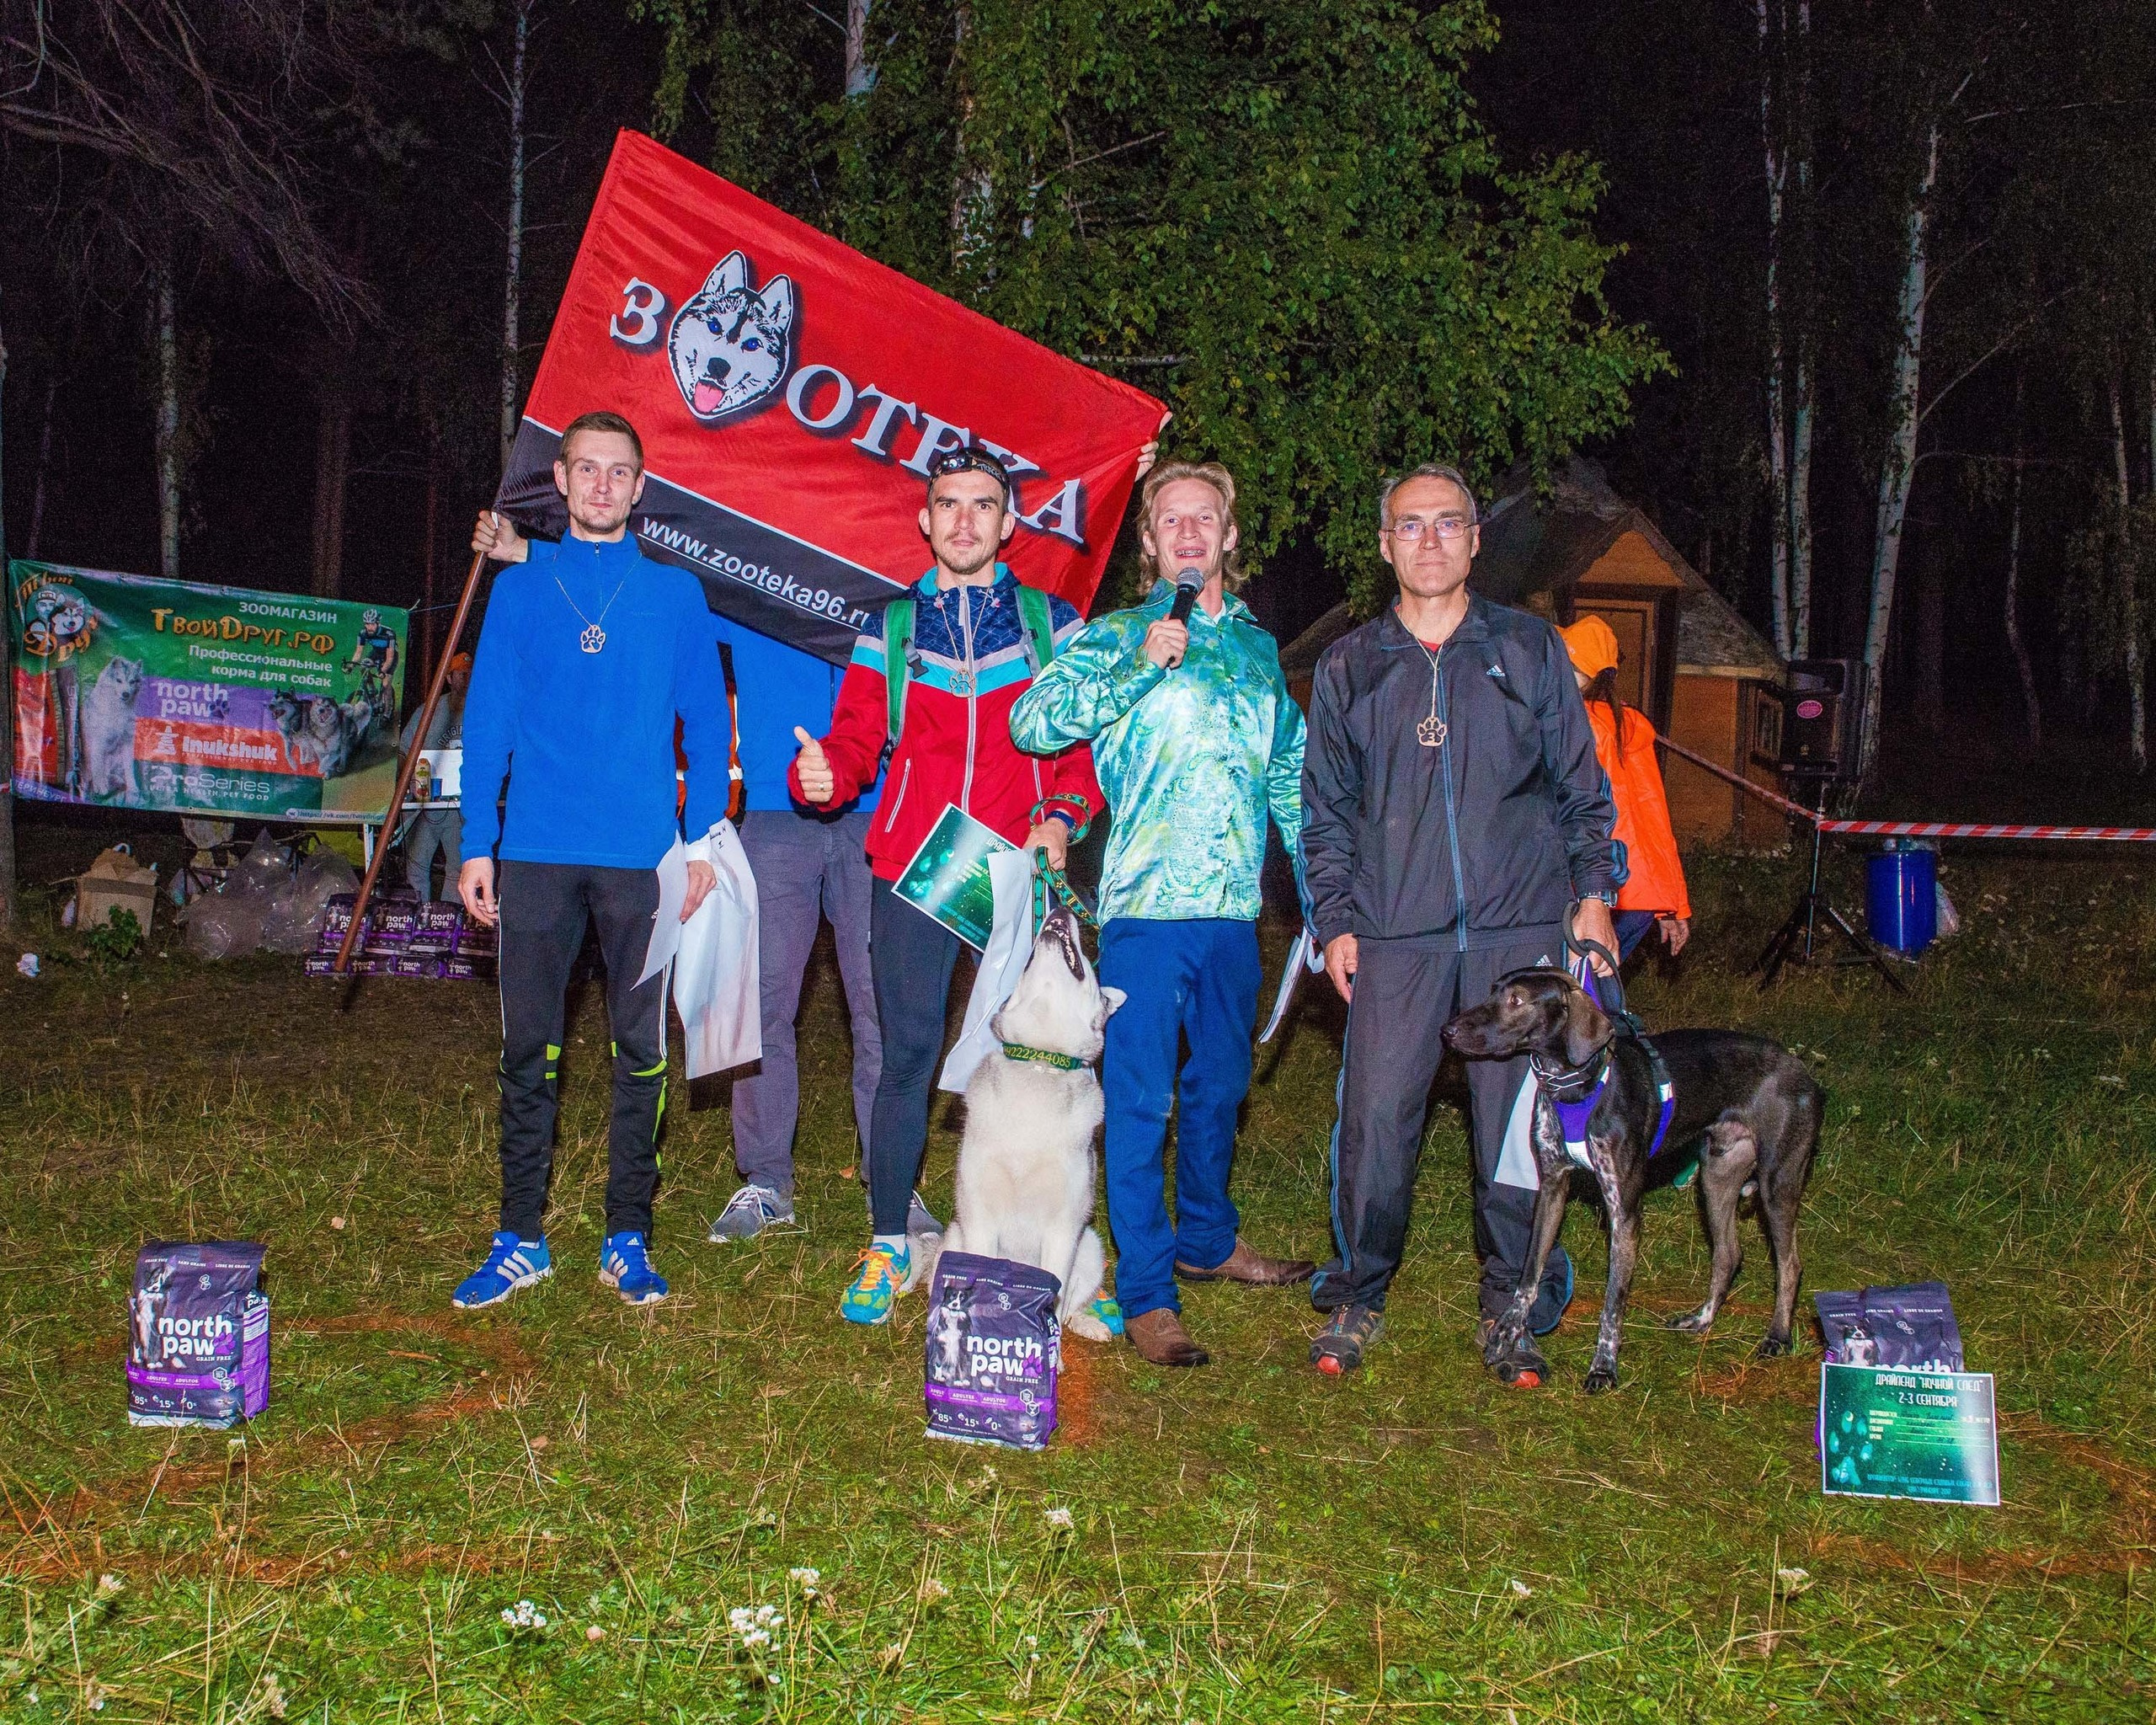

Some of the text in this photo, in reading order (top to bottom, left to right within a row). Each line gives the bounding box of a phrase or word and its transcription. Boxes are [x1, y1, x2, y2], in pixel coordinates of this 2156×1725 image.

[238, 601, 337, 624] ЗООМАГАЗИН
[189, 644, 333, 672] Профессиональные
[211, 665, 332, 686] корма для собак
[157, 681, 228, 701] north
[161, 698, 211, 718] paw
[182, 735, 277, 761] Inukshuk
[387, 915, 413, 923] north
[158, 1315, 232, 1338] north
[163, 1337, 216, 1359] paw
[967, 1334, 1042, 1358] north
[970, 1354, 1024, 1377] paw
[1876, 1373, 1916, 1389] ДРАЙЛЕНД
[1898, 1392, 1957, 1407] 2-3 СЕНТЯБРЯ
